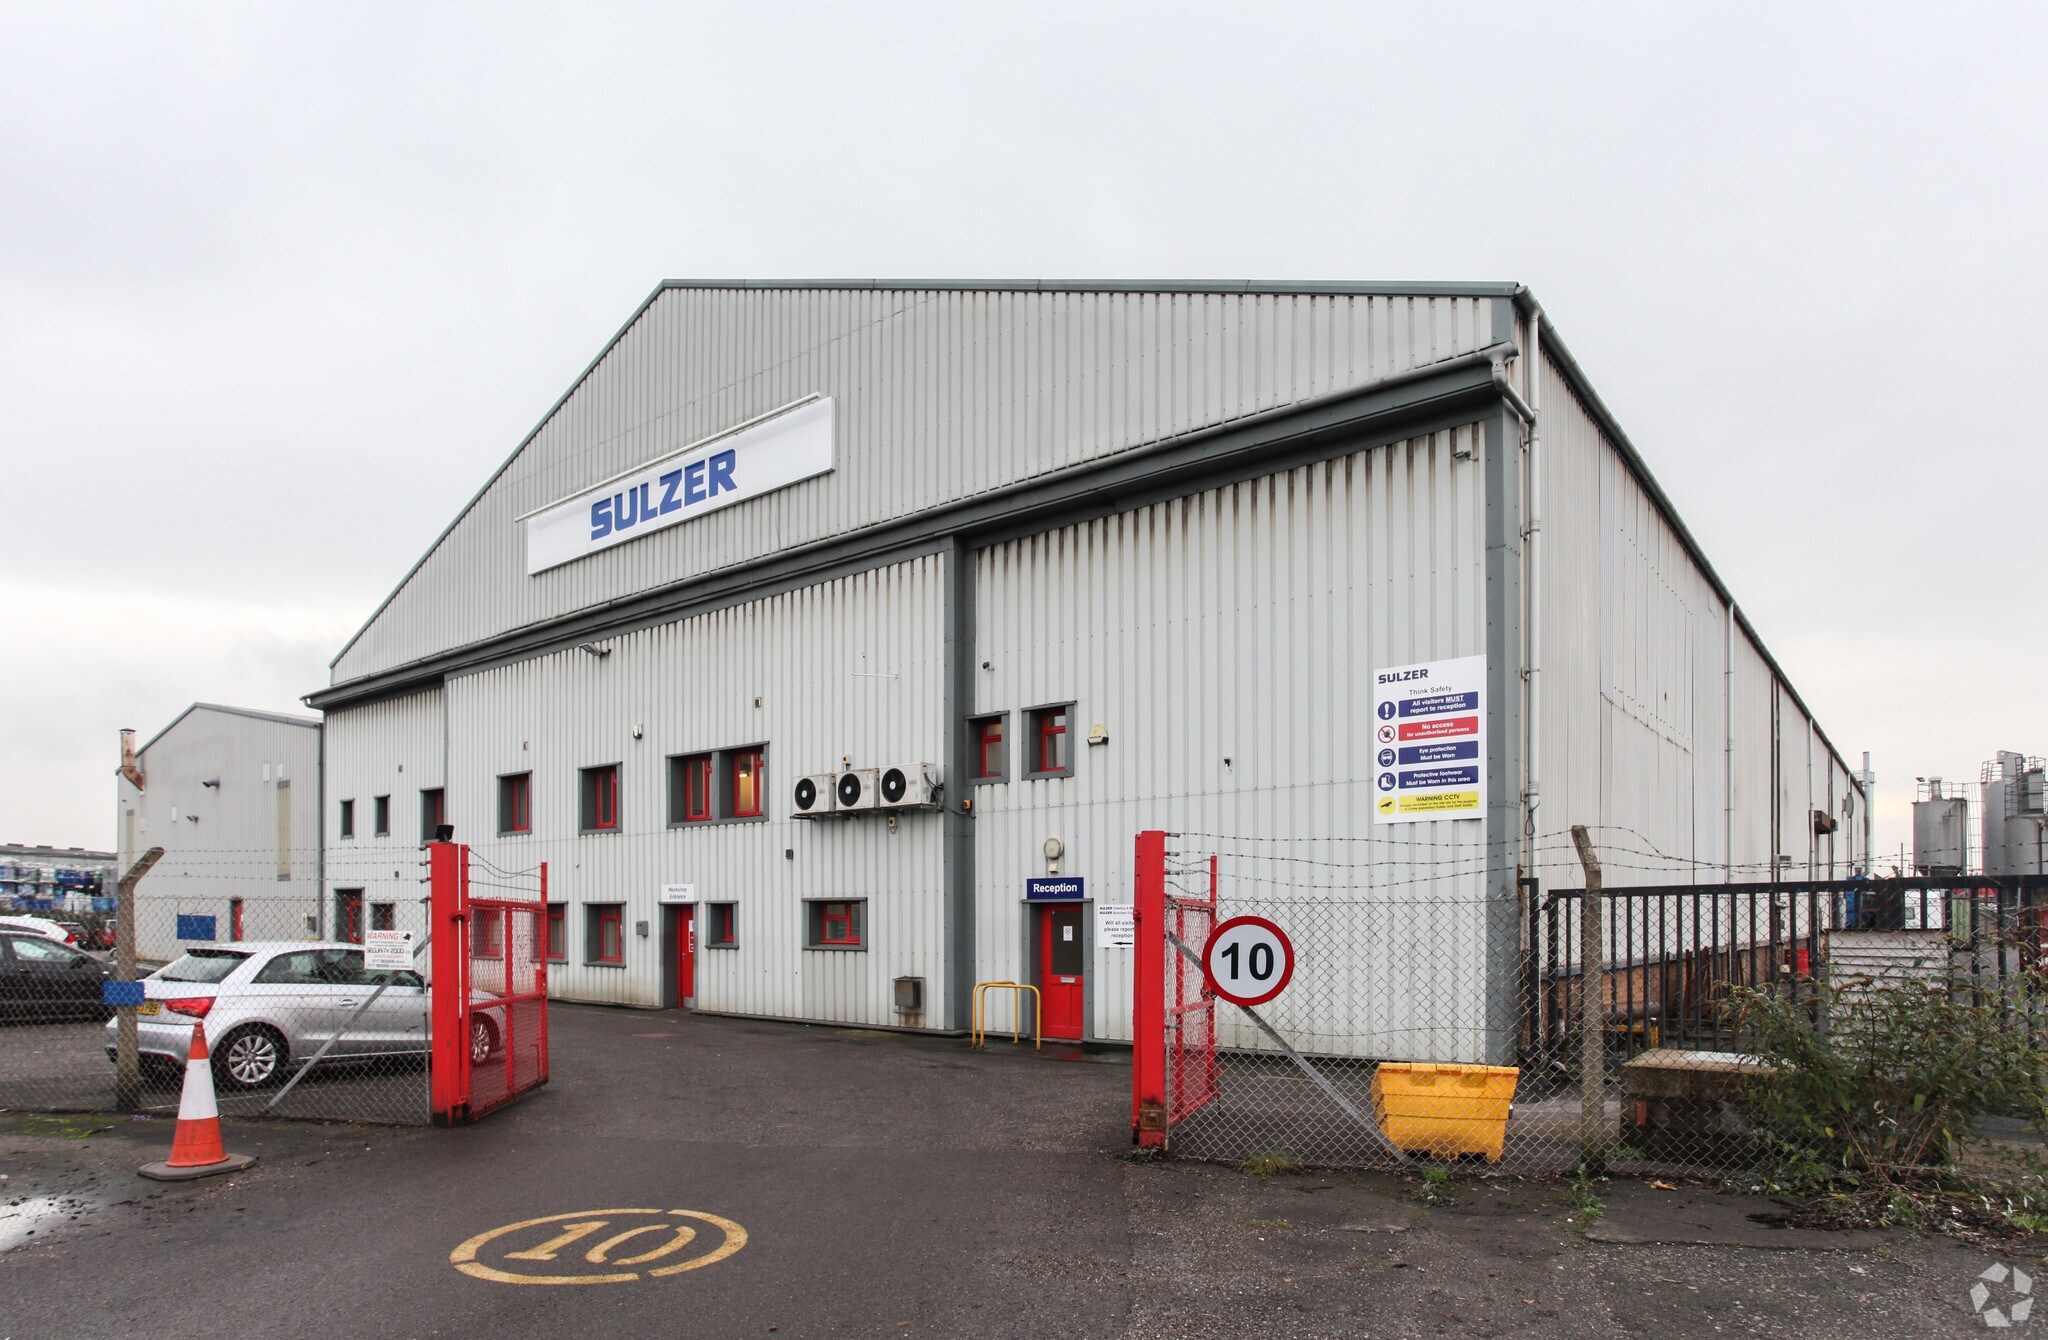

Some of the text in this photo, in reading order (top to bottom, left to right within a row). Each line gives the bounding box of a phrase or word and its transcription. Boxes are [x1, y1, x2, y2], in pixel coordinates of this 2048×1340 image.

[591, 448, 738, 541] SULZER
[1379, 669, 1428, 684] SULZER
[1409, 686, 1452, 696] Think Safety
[1422, 697, 1445, 705] visitors
[1445, 694, 1464, 703] MUST
[1410, 706, 1429, 714] report
[1437, 701, 1467, 711] reception
[1432, 721, 1454, 729] access
[1415, 728, 1448, 737] unauthorised
[1419, 745, 1457, 755] Eye protection
[1439, 769, 1464, 777] footwear
[1033, 883, 1078, 894] Reception
[367, 932, 399, 940] WARNING
[1221, 942, 1274, 981] 10
[503, 1221, 697, 1266] 10
